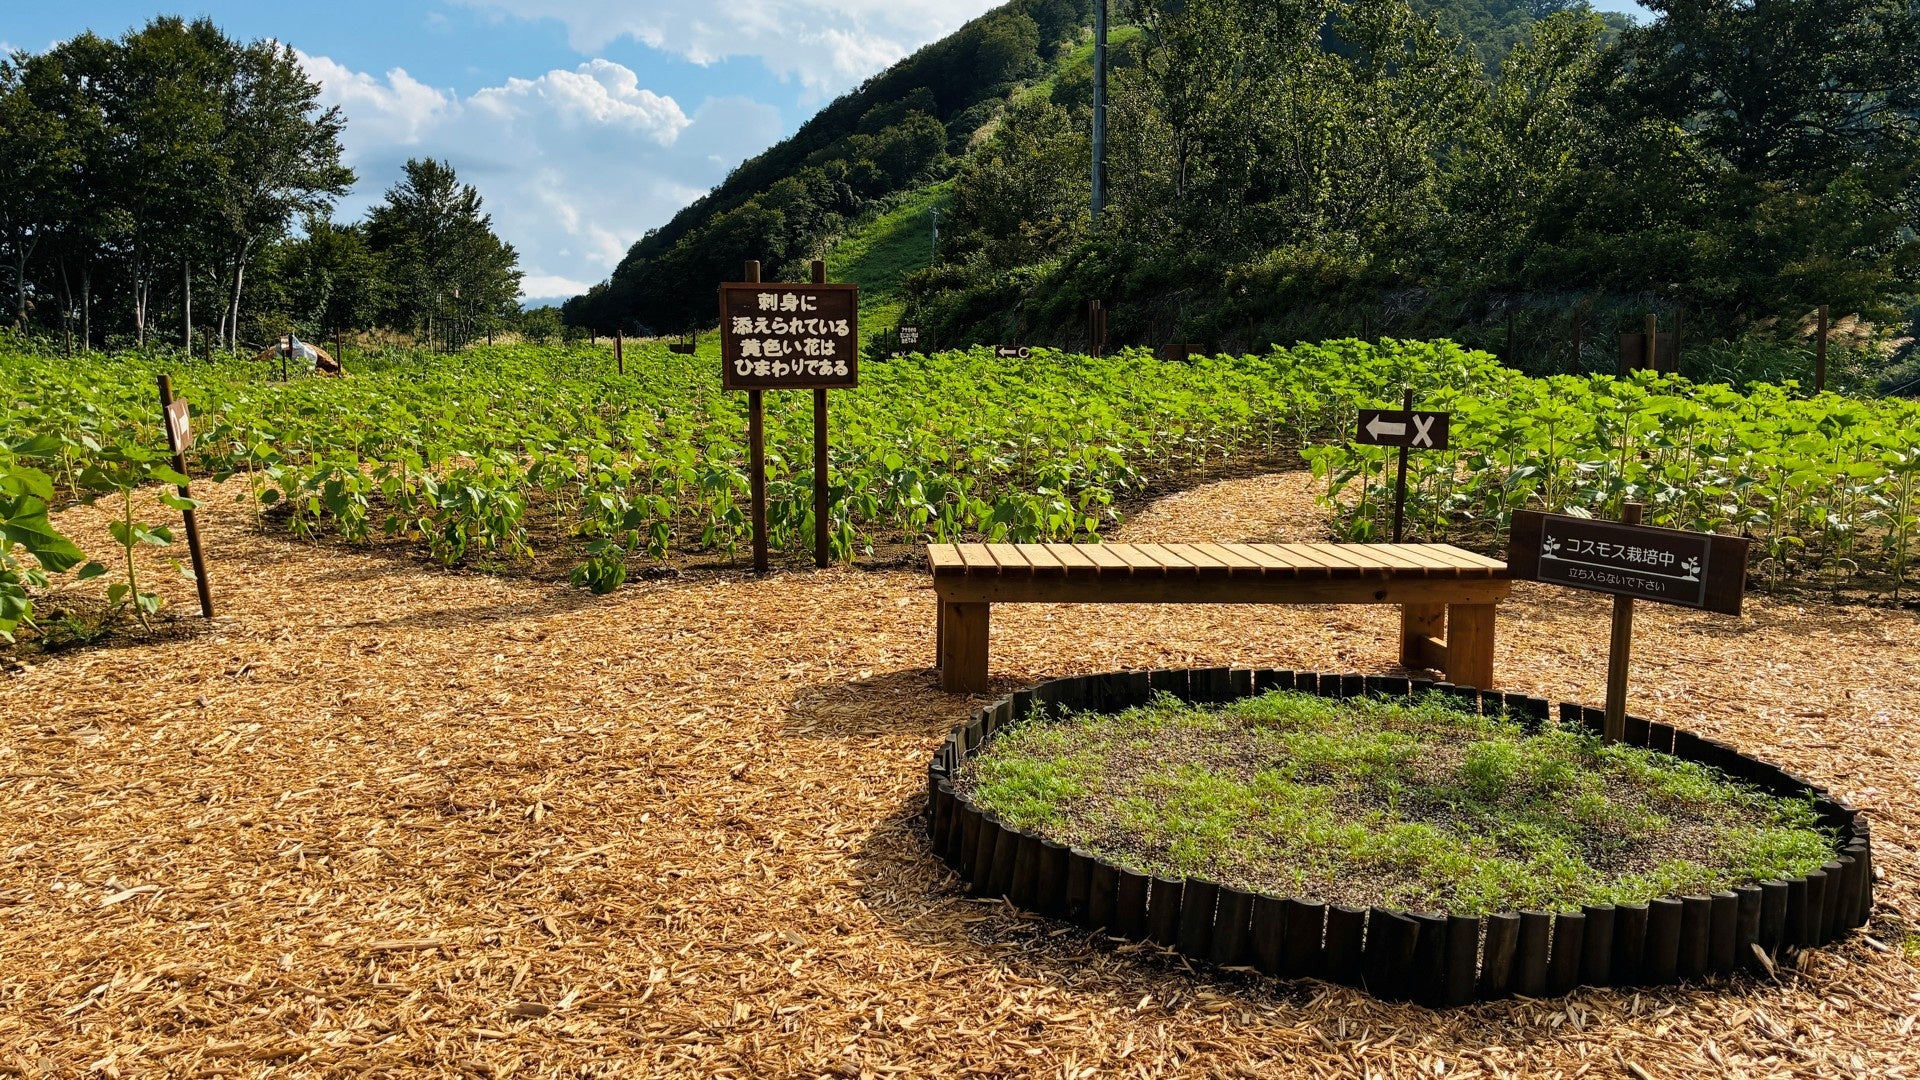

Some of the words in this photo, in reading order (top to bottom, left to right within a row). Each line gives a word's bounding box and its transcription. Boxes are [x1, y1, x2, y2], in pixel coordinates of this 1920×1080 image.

[758, 292, 817, 312] 刺身に
[732, 316, 850, 337] 添えられている
[740, 338, 836, 357] 黄色い花は
[734, 358, 849, 377] ひまわりである
[1566, 538, 1675, 568] コスモス栽培中
[1568, 567, 1666, 591] 立ち入らないで下さい
